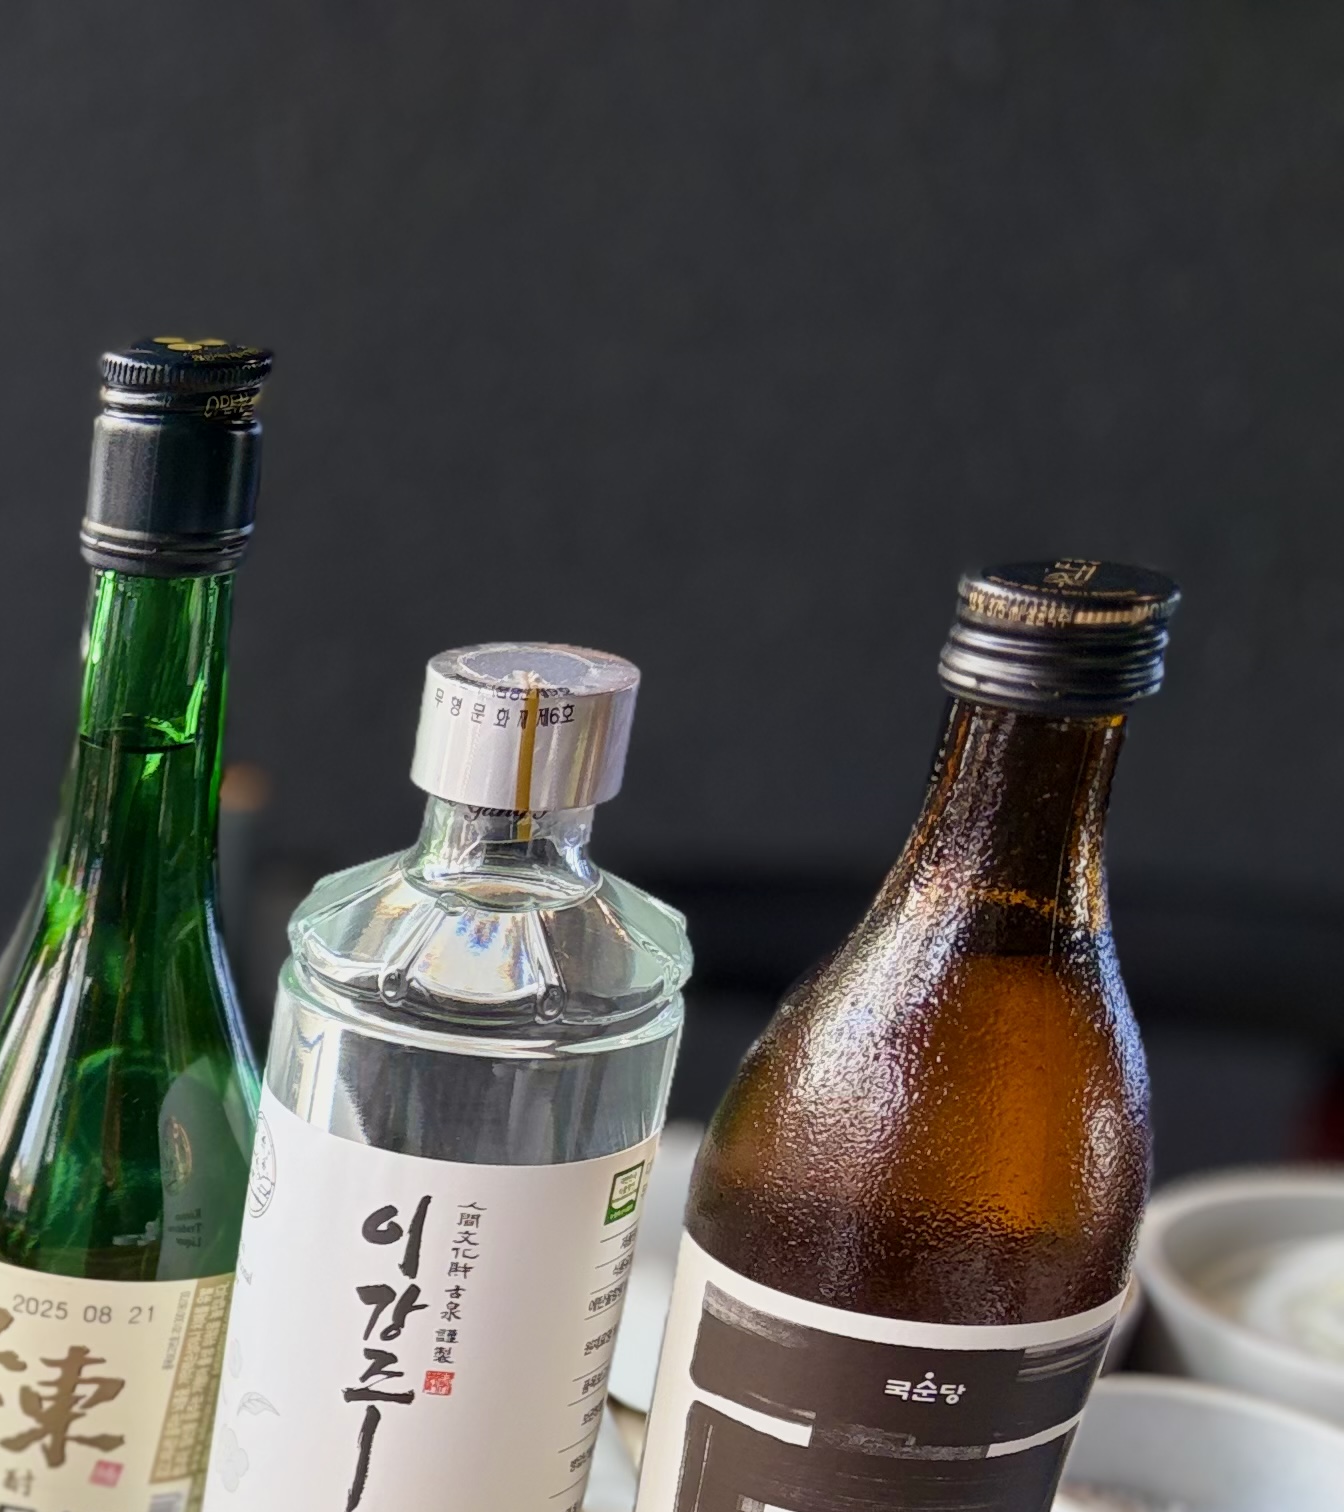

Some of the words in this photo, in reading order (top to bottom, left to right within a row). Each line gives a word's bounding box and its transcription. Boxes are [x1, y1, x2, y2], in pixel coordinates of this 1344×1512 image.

[12, 1293, 68, 1321] 2025
[83, 1304, 113, 1324] 08
[128, 1305, 155, 1325] 21
[884, 1371, 967, 1405] 국순당
